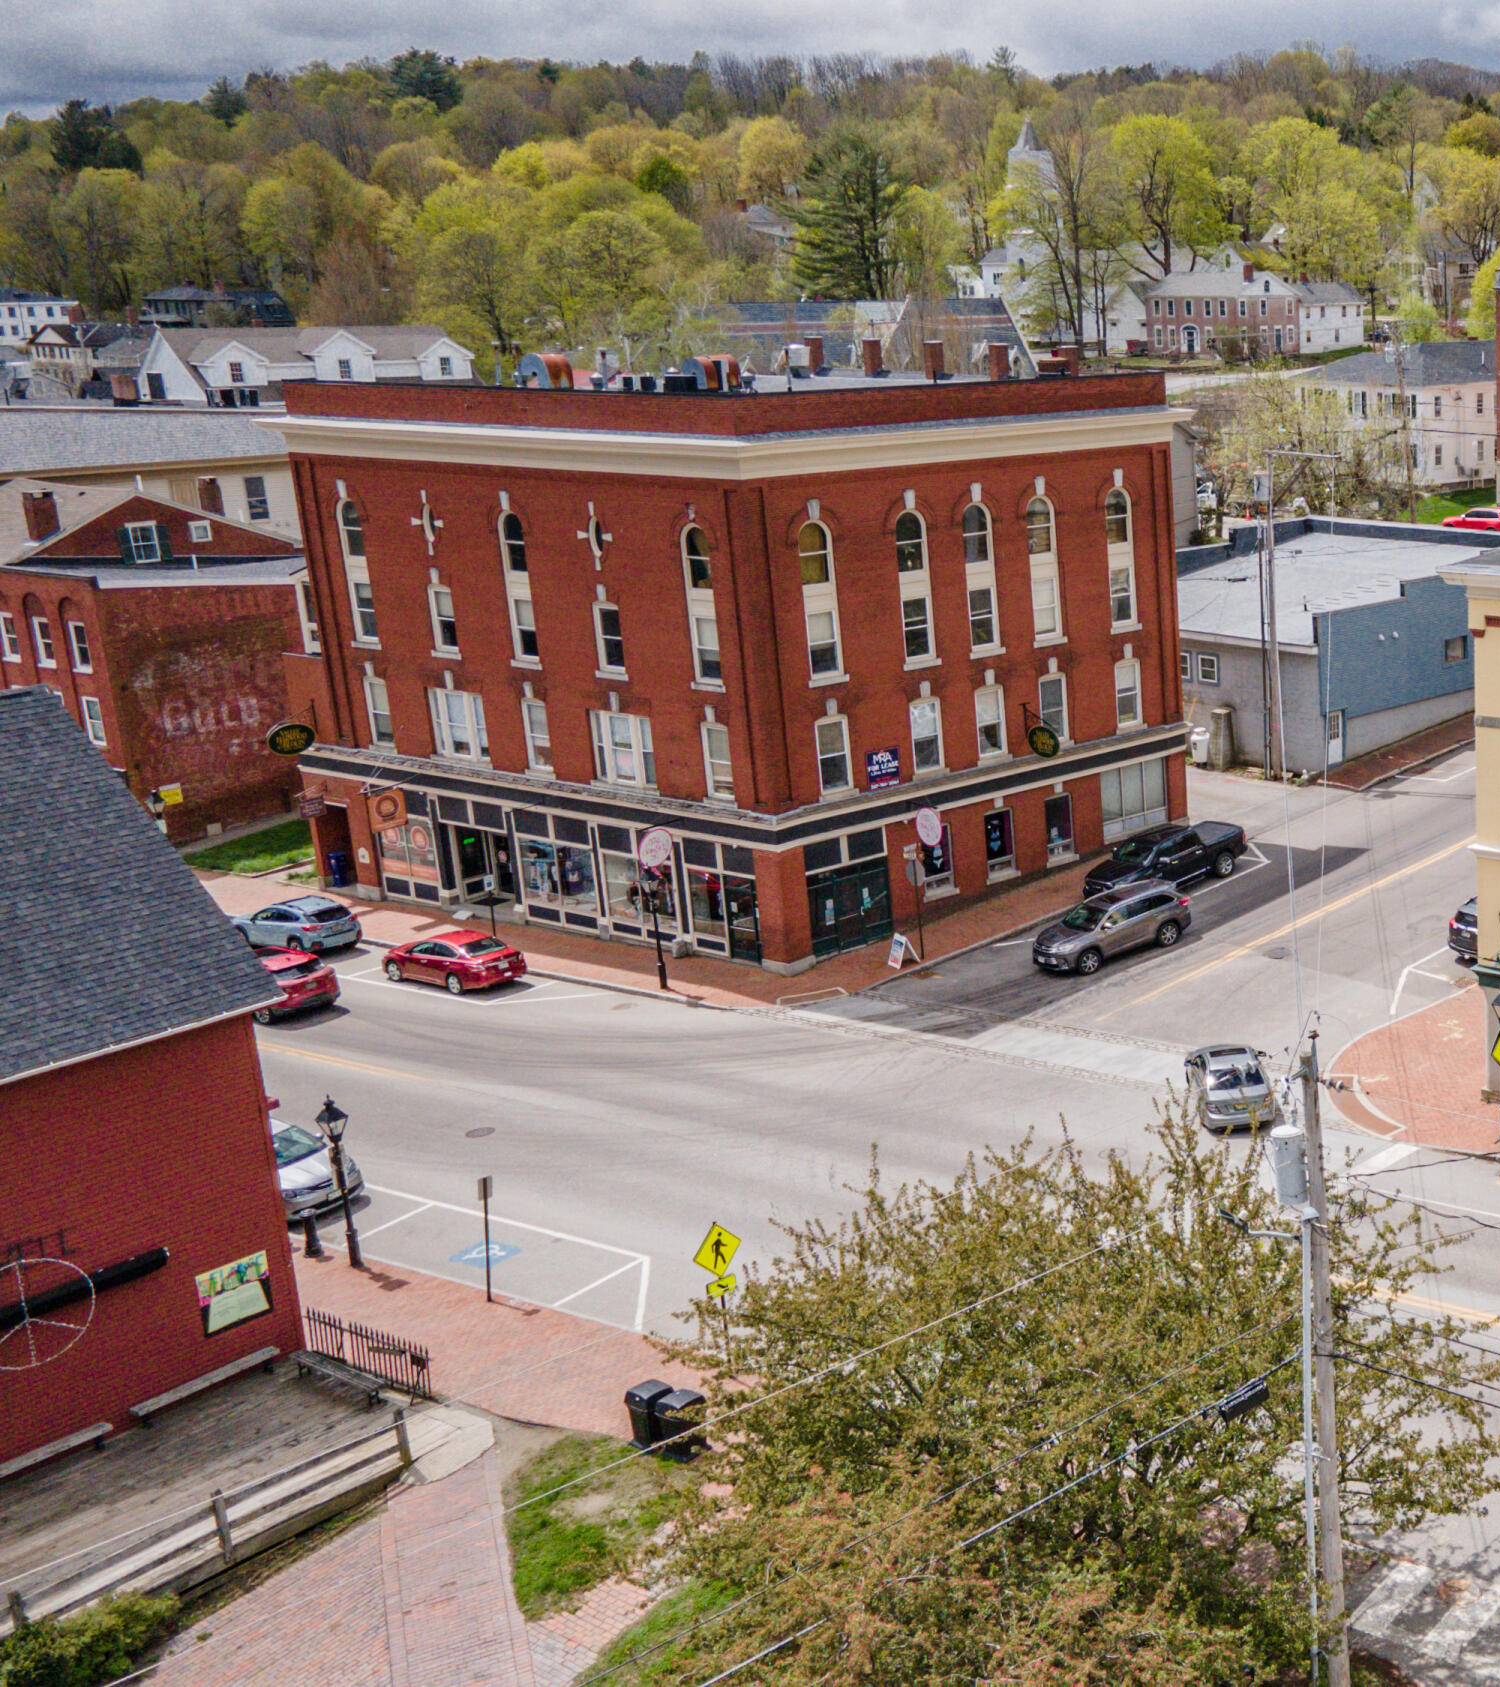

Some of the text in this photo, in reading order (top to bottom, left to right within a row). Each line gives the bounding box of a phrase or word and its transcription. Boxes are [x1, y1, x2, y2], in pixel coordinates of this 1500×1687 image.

[872, 751, 892, 764] MRA
[867, 764, 879, 773] FOR
[881, 760, 899, 769] LEASE
